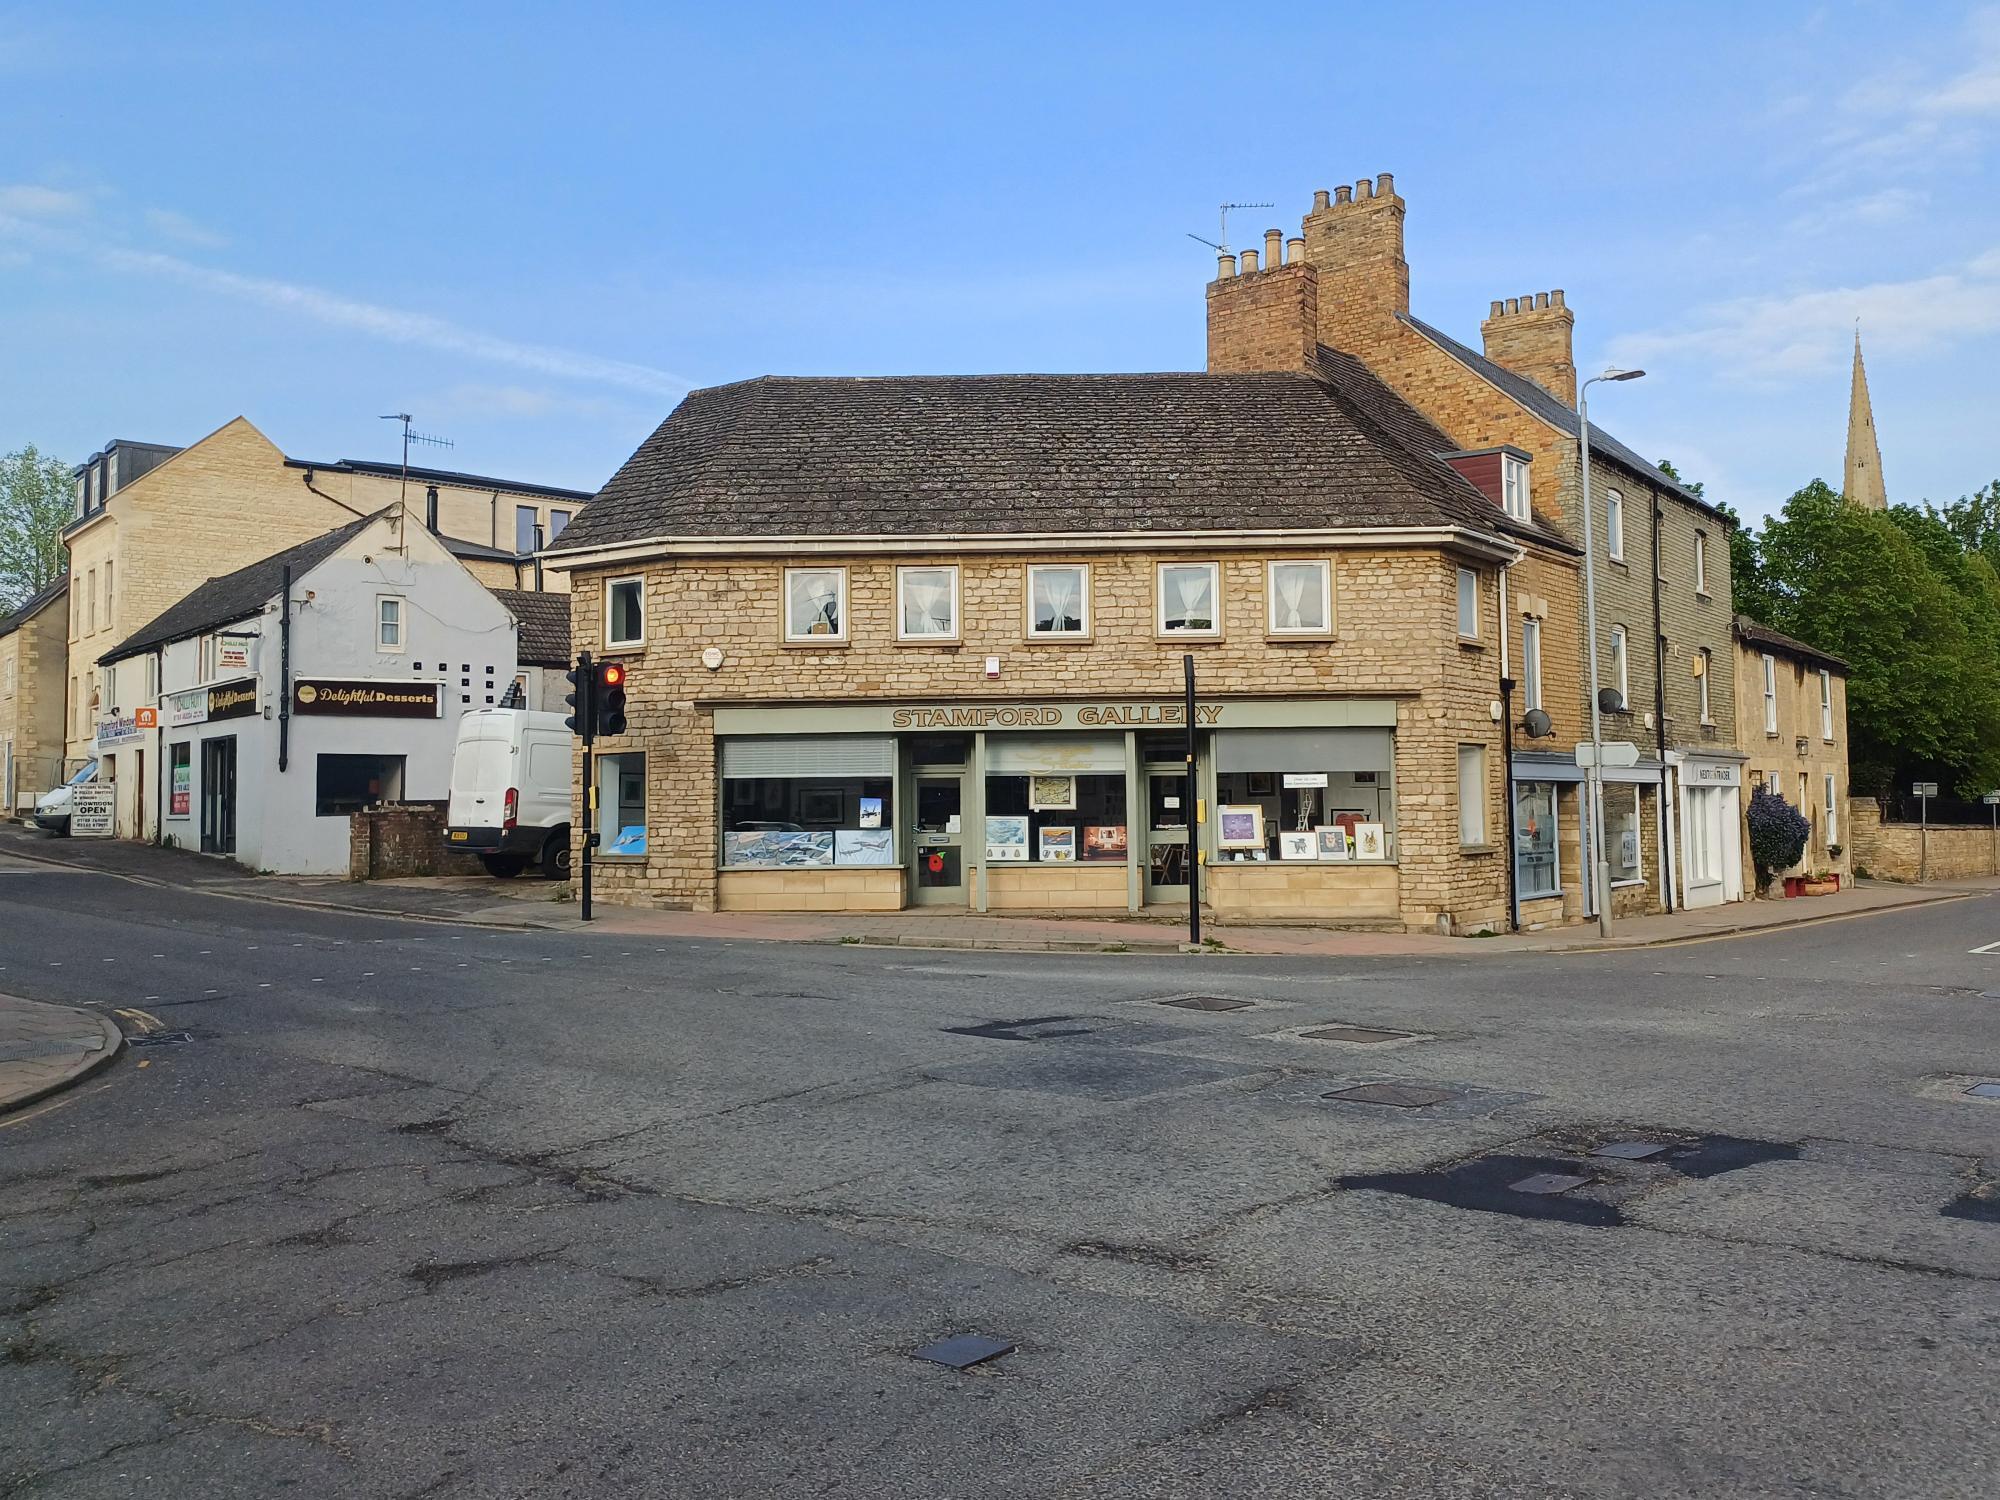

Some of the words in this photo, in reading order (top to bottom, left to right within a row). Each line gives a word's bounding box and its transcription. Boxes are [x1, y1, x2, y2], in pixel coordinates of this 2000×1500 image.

[234, 689, 256, 703] Desserts
[320, 687, 375, 705] Delightful
[375, 692, 434, 703] Desserts
[893, 707, 1062, 728] STAMFORD
[1078, 705, 1223, 725] GALLERY
[80, 806, 106, 814] OPEN
